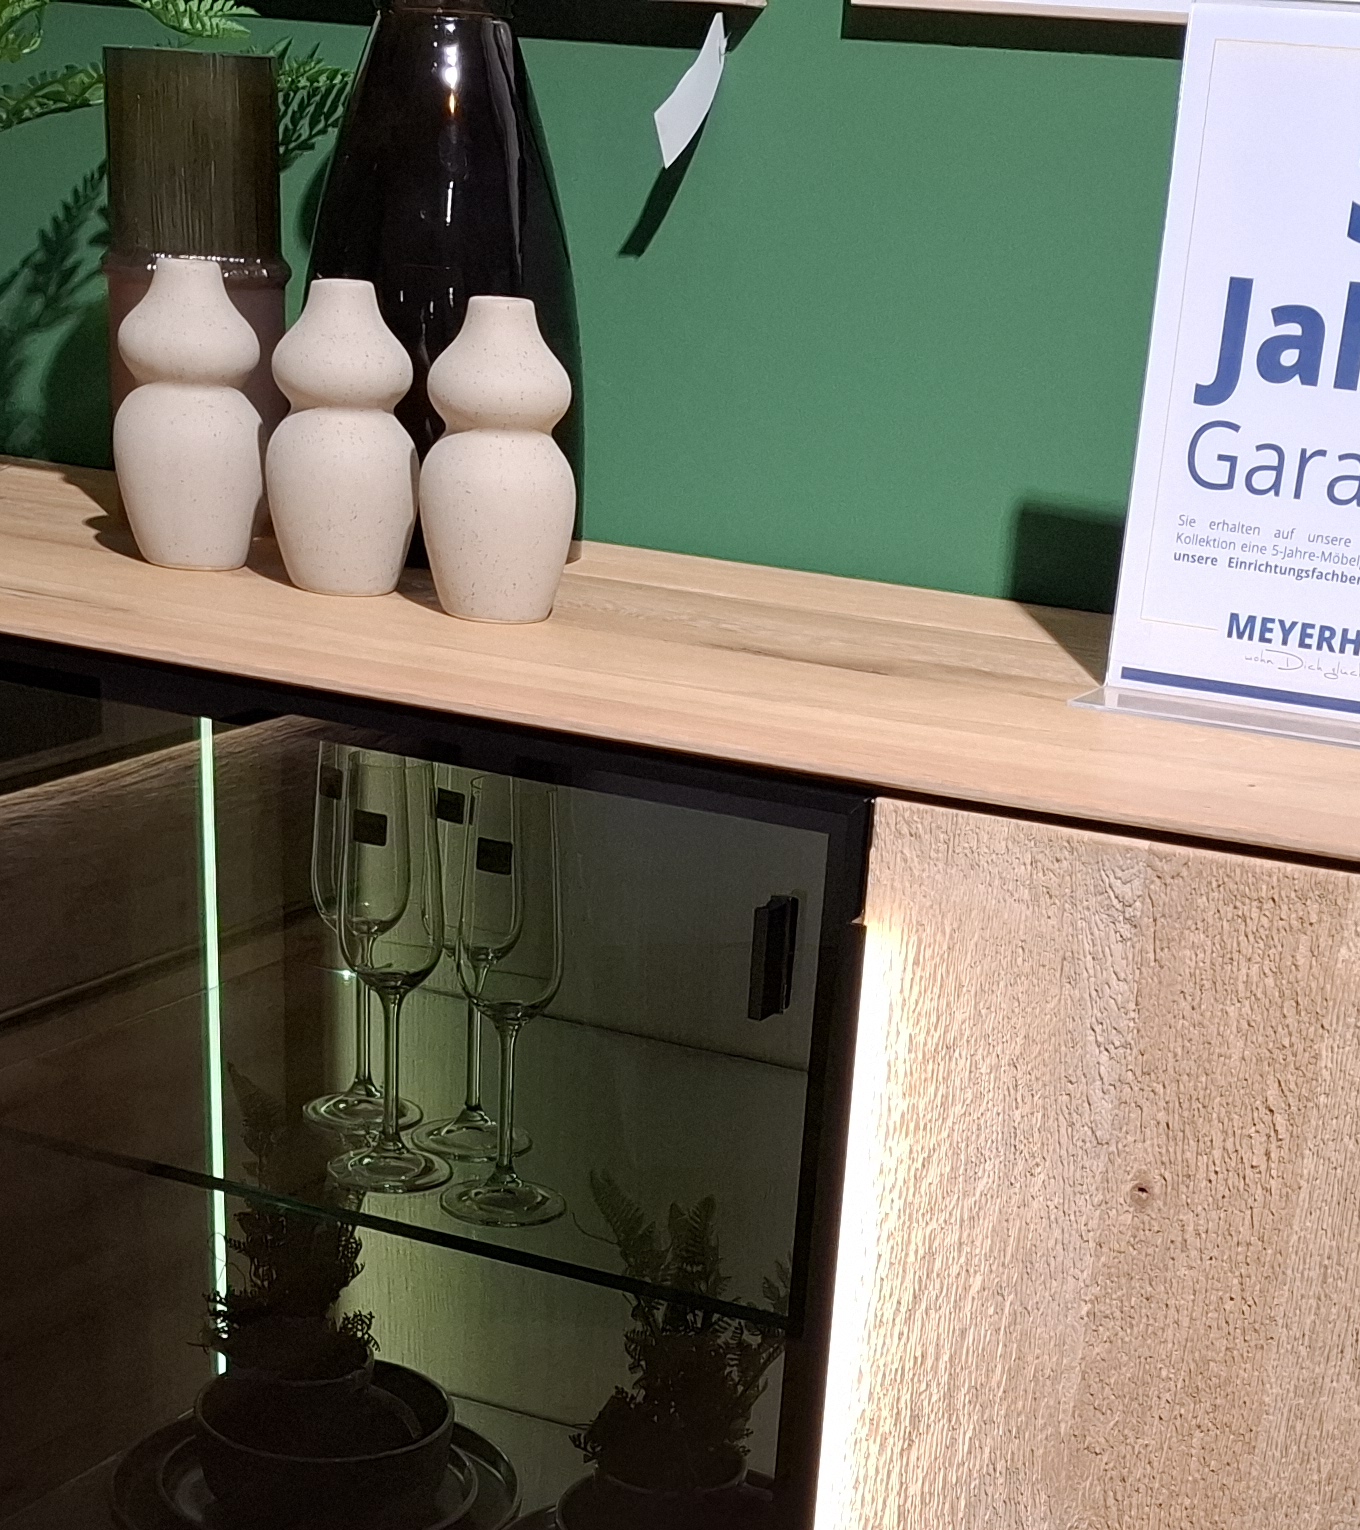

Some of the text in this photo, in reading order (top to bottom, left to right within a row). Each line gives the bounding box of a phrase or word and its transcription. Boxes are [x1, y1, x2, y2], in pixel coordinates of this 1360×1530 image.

[1178, 514, 1196, 528] Sie
[1208, 519, 1261, 536] erhalten
[1273, 527, 1296, 541] auf
[1307, 532, 1352, 548] unsere
[1175, 531, 1236, 551] Kollektion
[1240, 541, 1267, 555] eine
[1173, 551, 1218, 566] unsere
[1244, 650, 1274, 666] wohn
[1264, 648, 1323, 671] Dich
